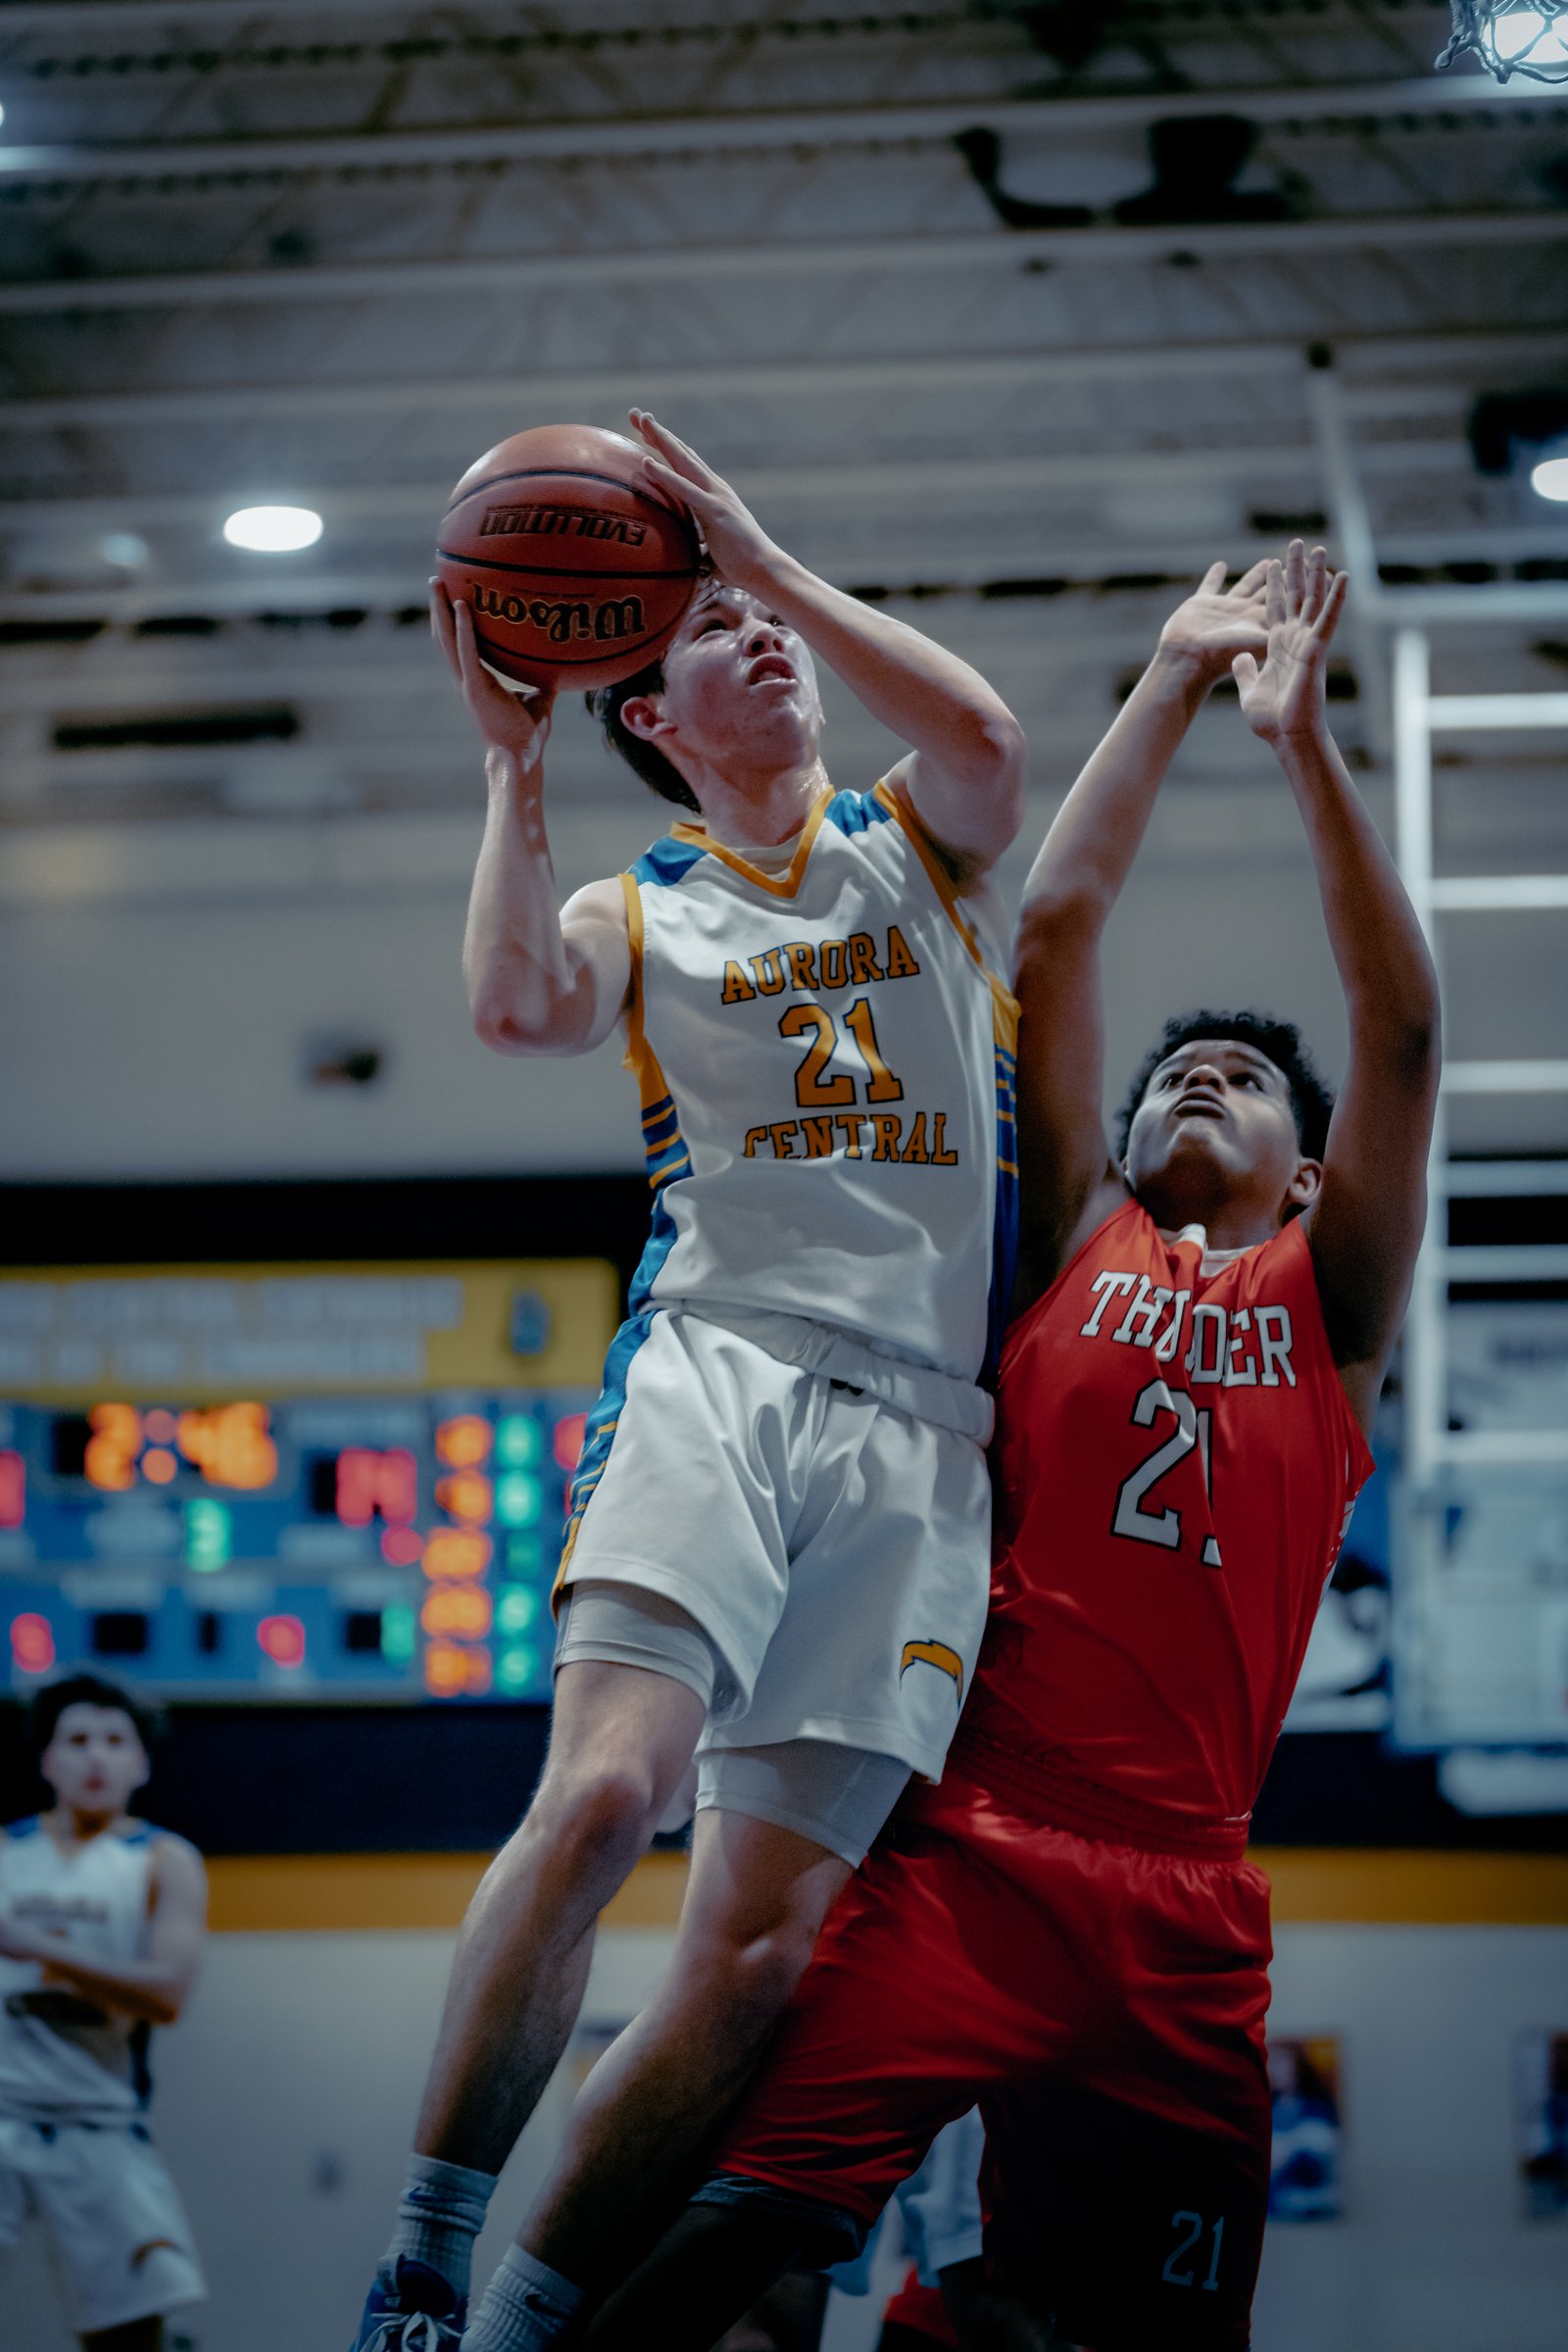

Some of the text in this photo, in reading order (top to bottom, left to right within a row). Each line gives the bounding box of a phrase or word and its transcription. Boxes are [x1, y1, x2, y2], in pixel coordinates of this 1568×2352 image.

[479, 510, 646, 546] EVOLUTION
[473, 583, 645, 643] Wilson
[720, 925, 920, 1005] AURORA
[778, 997, 904, 1107] 21
[1080, 1270, 1298, 1388] THUDER
[1161, 2210, 1224, 2290] 21
